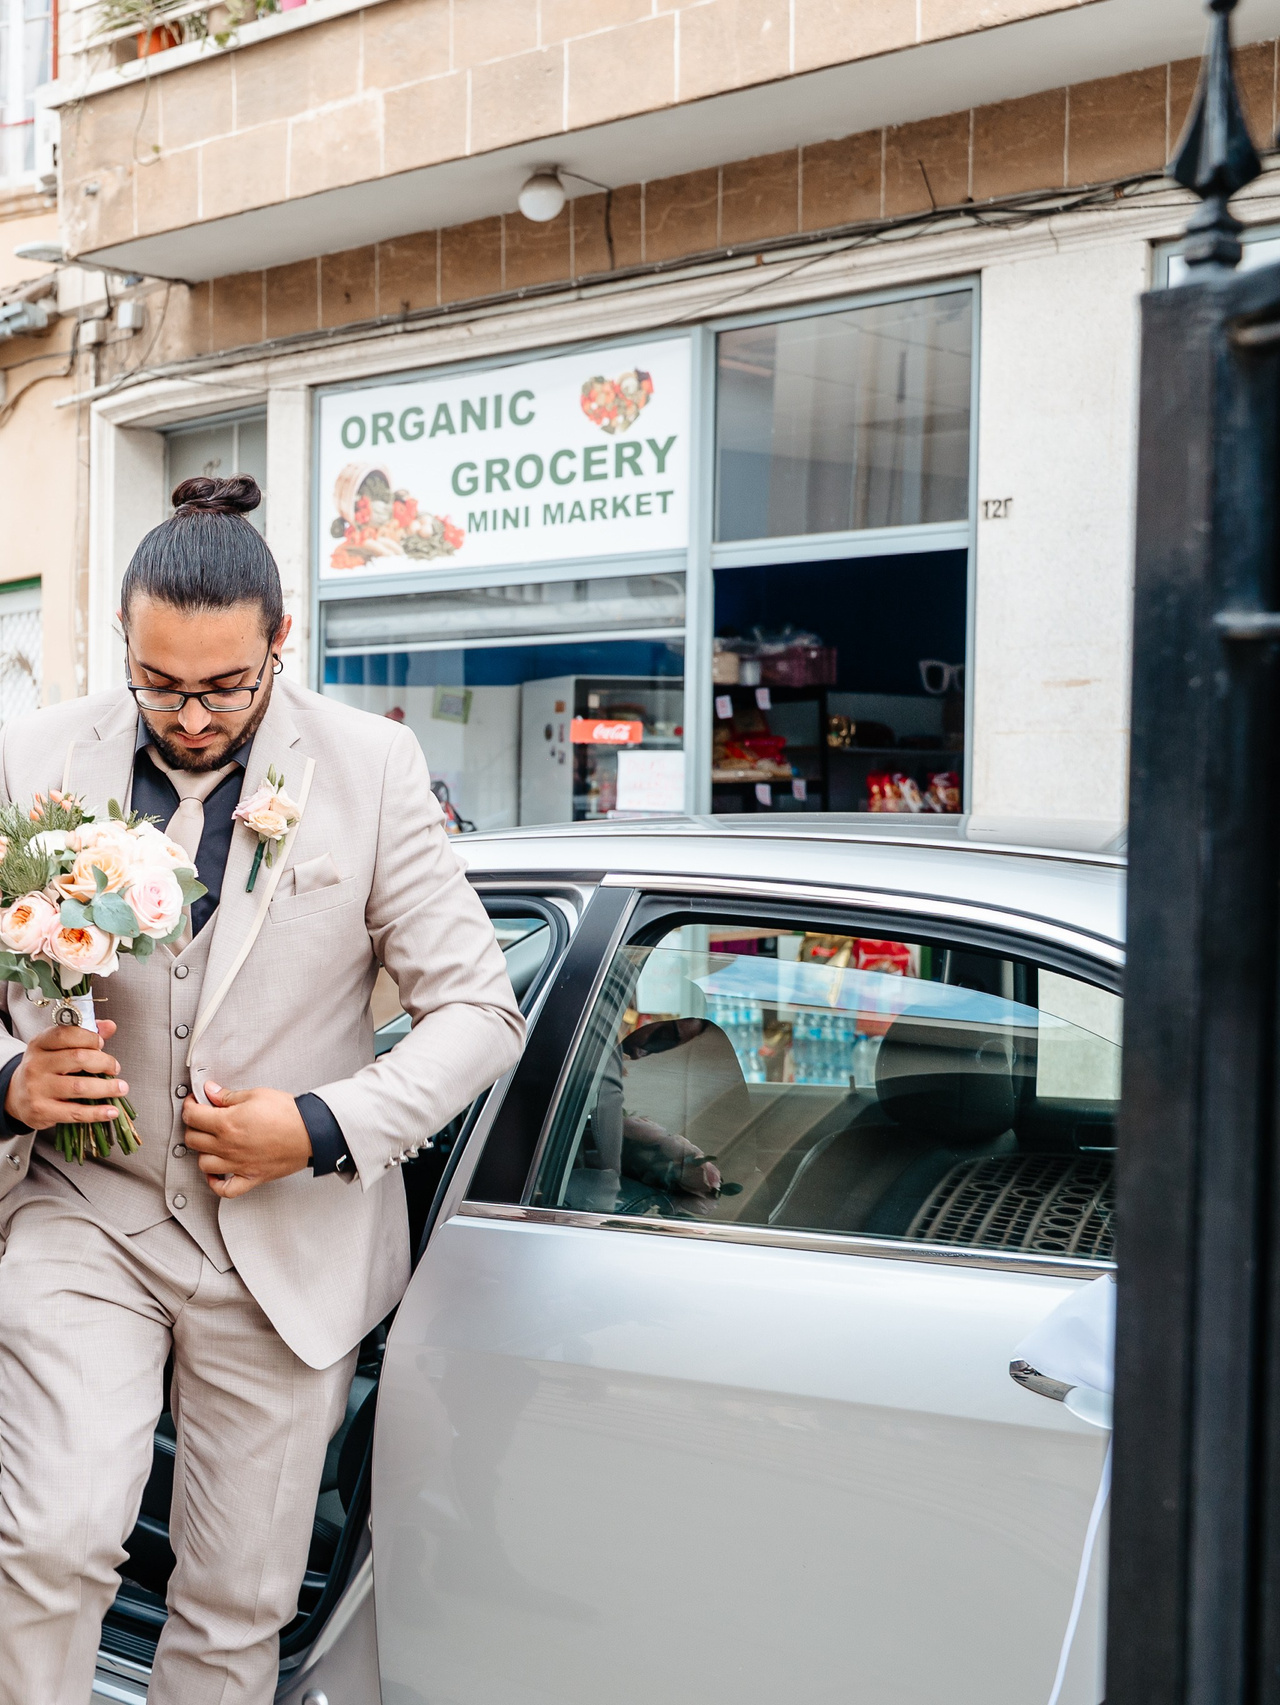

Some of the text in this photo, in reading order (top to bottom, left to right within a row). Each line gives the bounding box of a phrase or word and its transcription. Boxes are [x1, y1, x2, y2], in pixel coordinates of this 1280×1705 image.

[340, 390, 536, 449] ORGANIC
[451, 435, 677, 497] GROCERY
[468, 490, 675, 533] MINI MARKET
